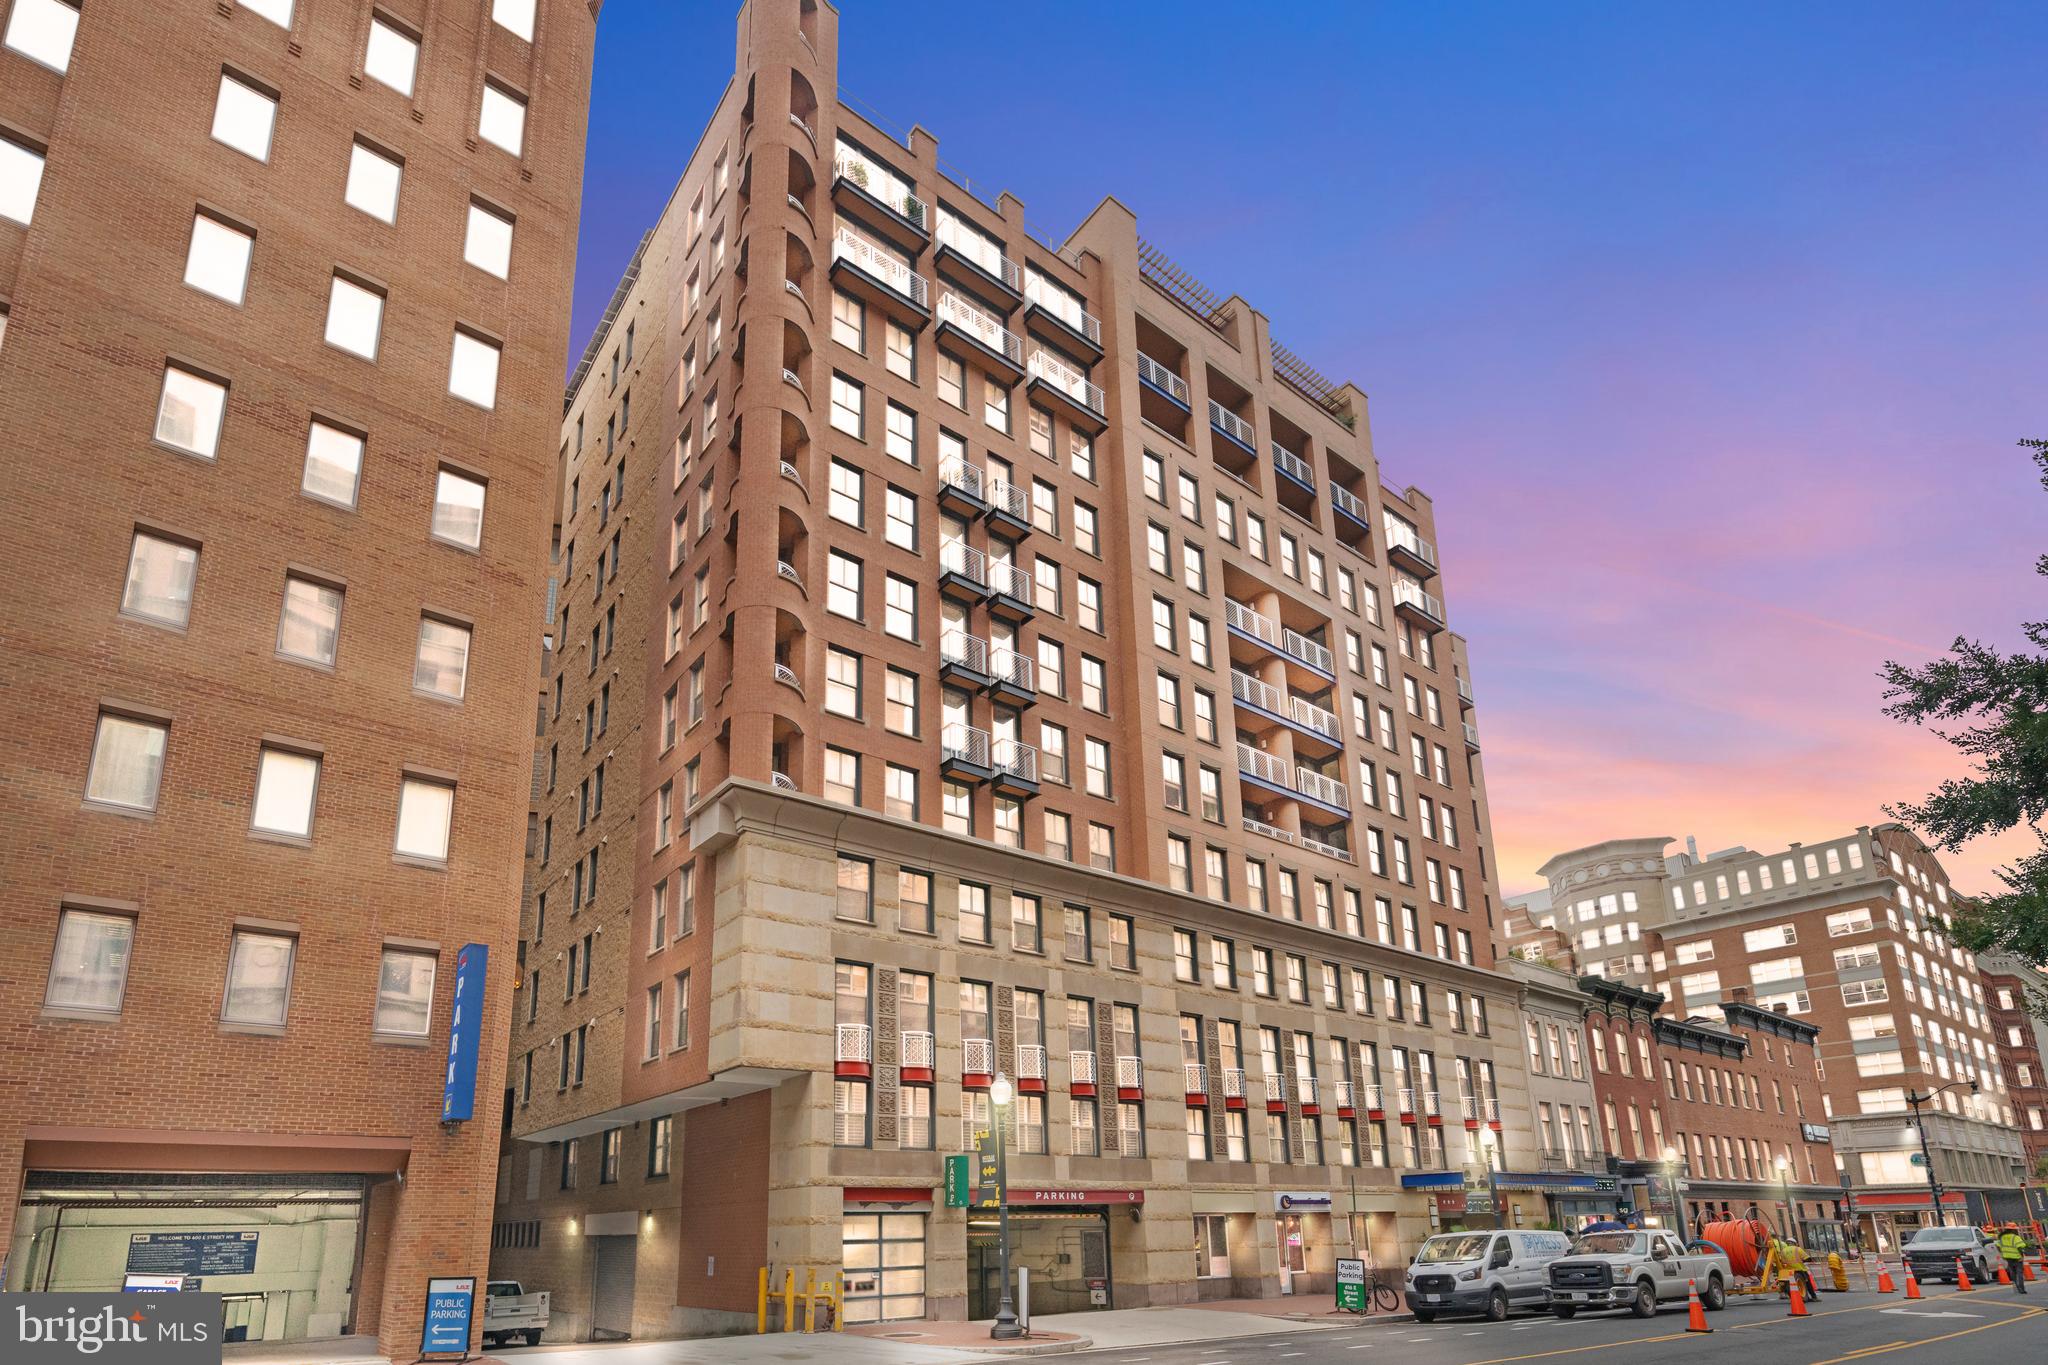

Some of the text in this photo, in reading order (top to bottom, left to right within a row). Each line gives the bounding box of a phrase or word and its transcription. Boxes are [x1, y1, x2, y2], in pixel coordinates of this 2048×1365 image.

[448, 976, 464, 1084] PARK
[1035, 1191, 1085, 1200] PARKING
[1338, 1272, 1362, 1280] Parking
[435, 1298, 464, 1308] PUBLIC
[430, 1309, 467, 1319] PARKING
